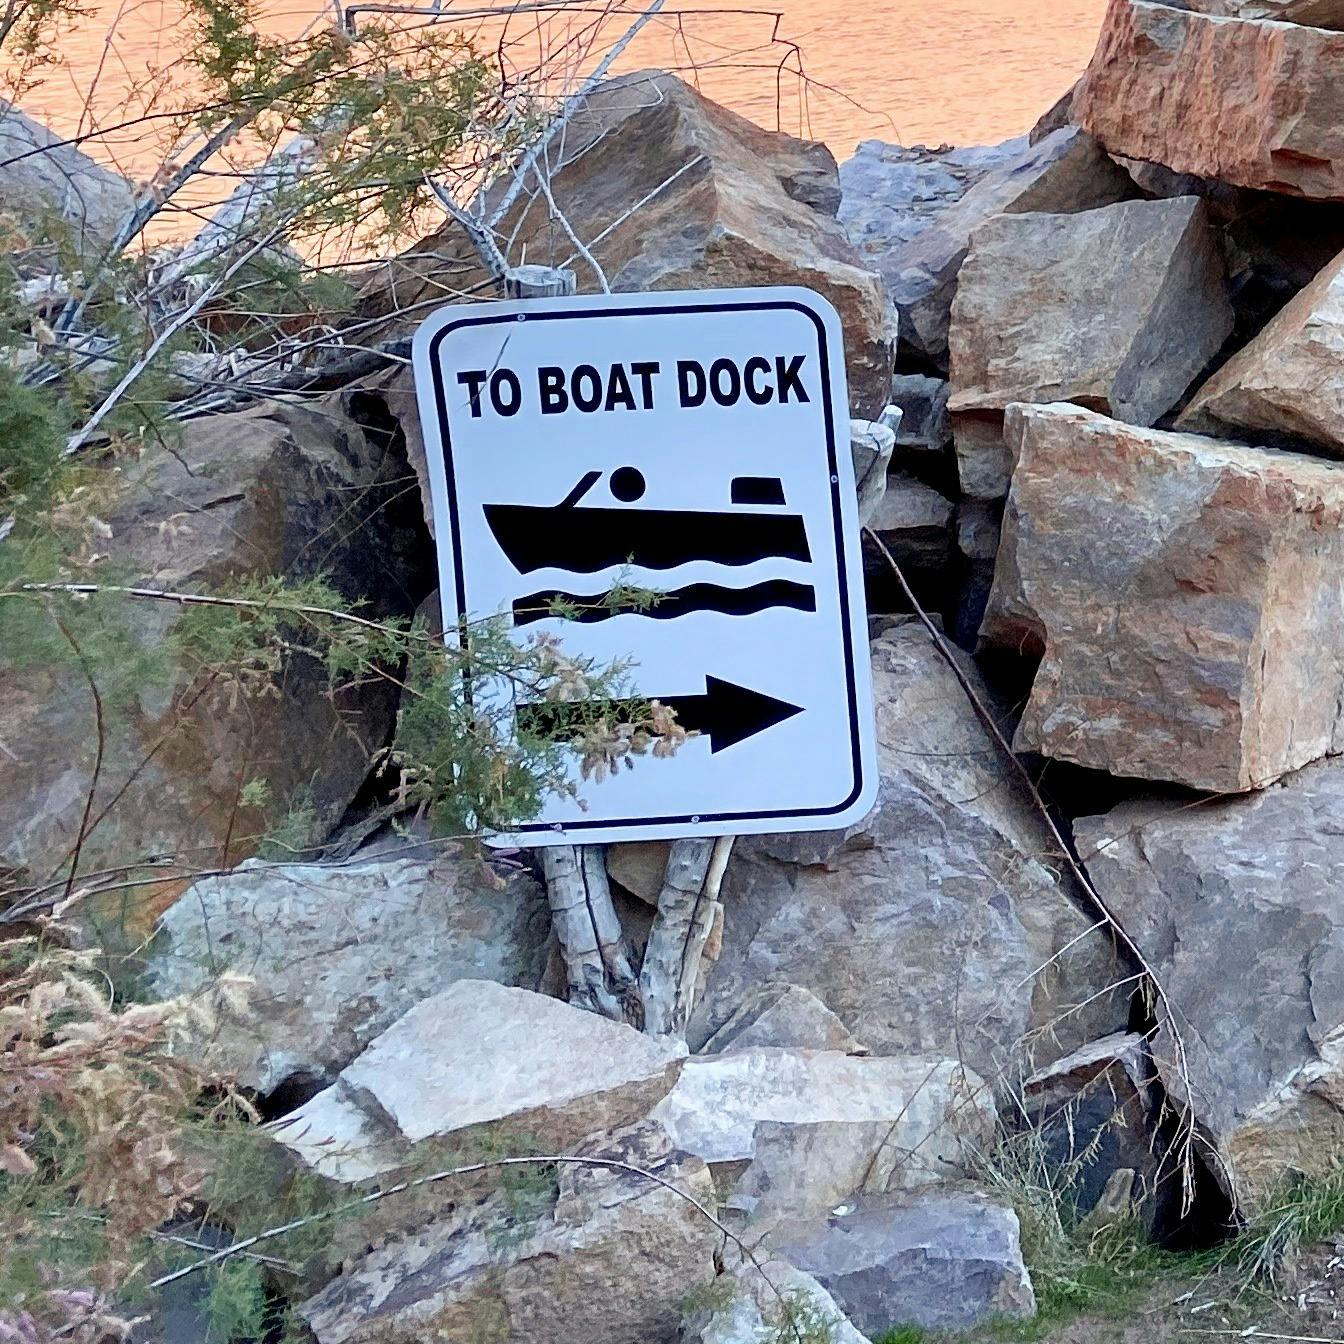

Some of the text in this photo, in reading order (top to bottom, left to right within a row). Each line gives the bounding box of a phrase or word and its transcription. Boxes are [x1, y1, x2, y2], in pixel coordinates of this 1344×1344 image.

[457, 355, 810, 418] TO BOAT DOCK
